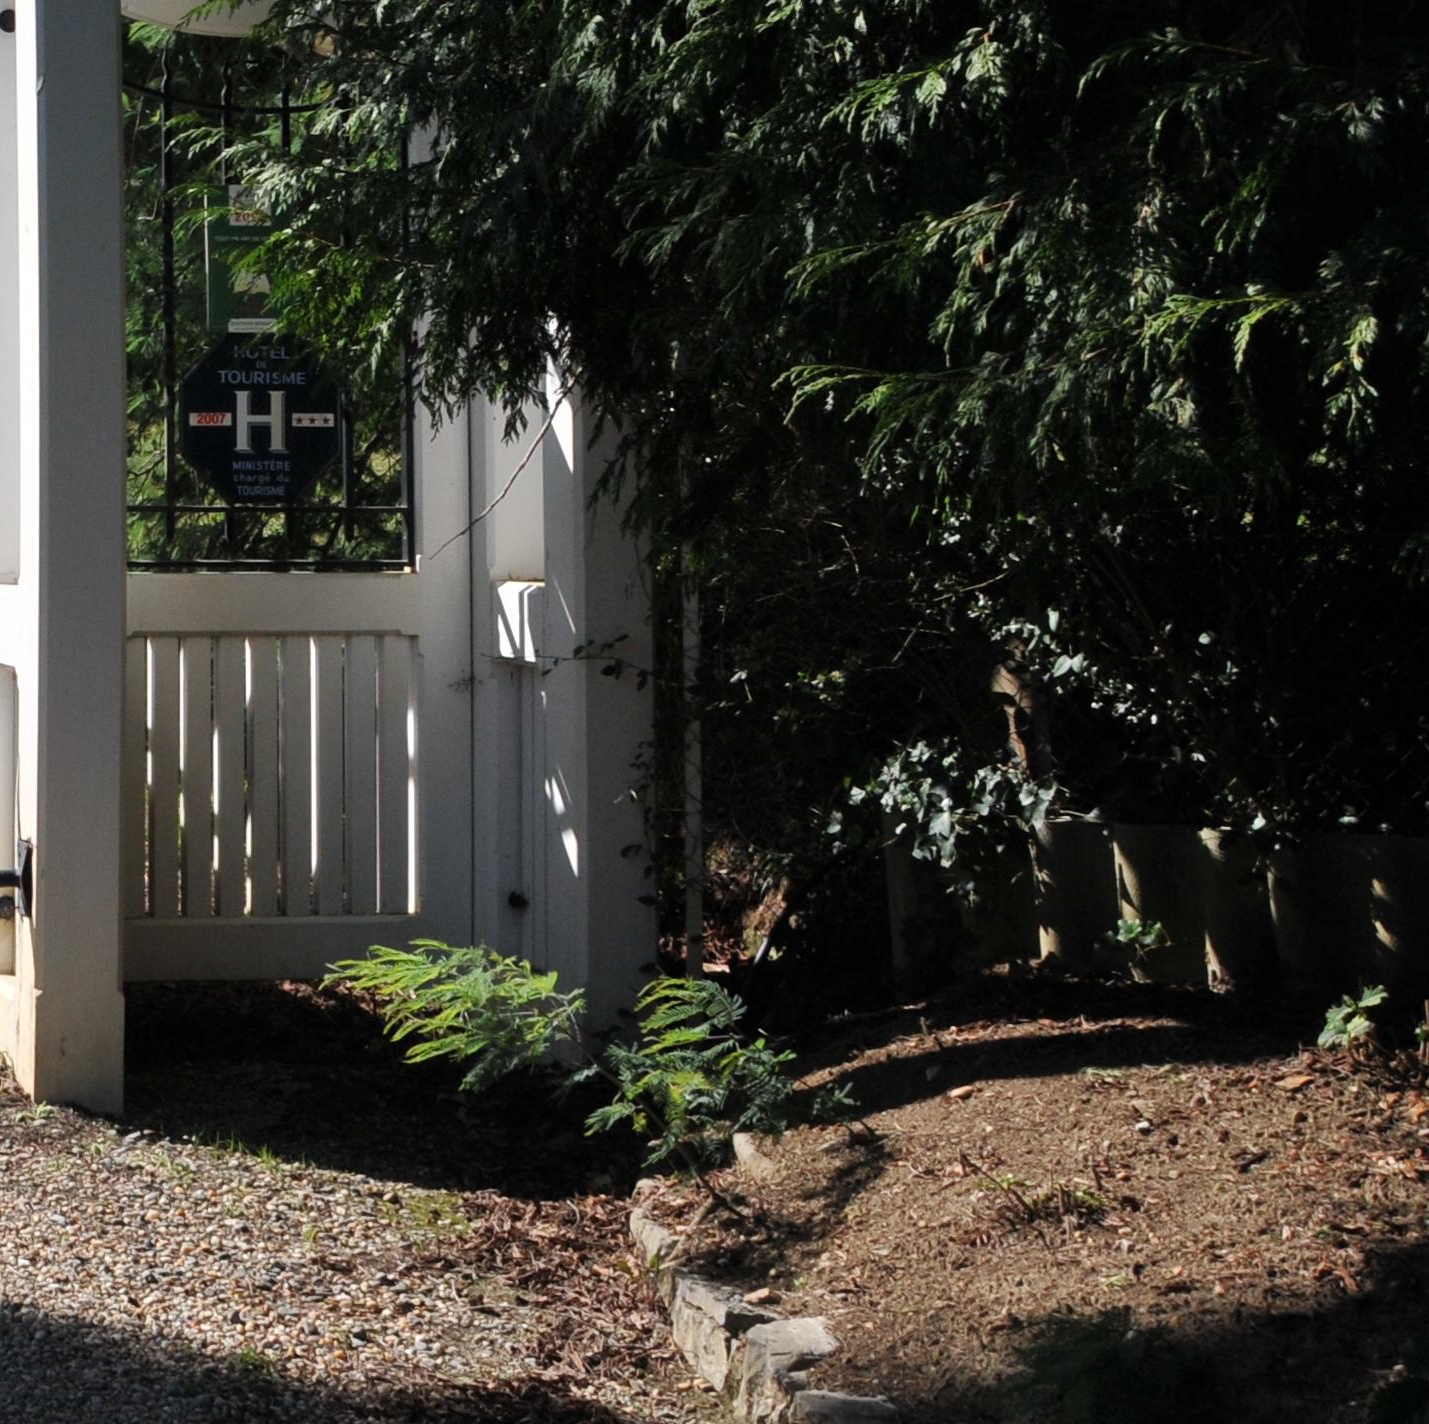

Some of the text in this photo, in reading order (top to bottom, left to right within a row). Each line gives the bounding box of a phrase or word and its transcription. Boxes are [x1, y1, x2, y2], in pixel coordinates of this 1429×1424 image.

[255, 360, 268, 369] DE
[217, 370, 307, 385] TOURISME
[197, 413, 226, 425] 2007
[233, 390, 290, 454] H
[233, 472, 290, 485] chargé du
[237, 485, 286, 496] TOURISME
